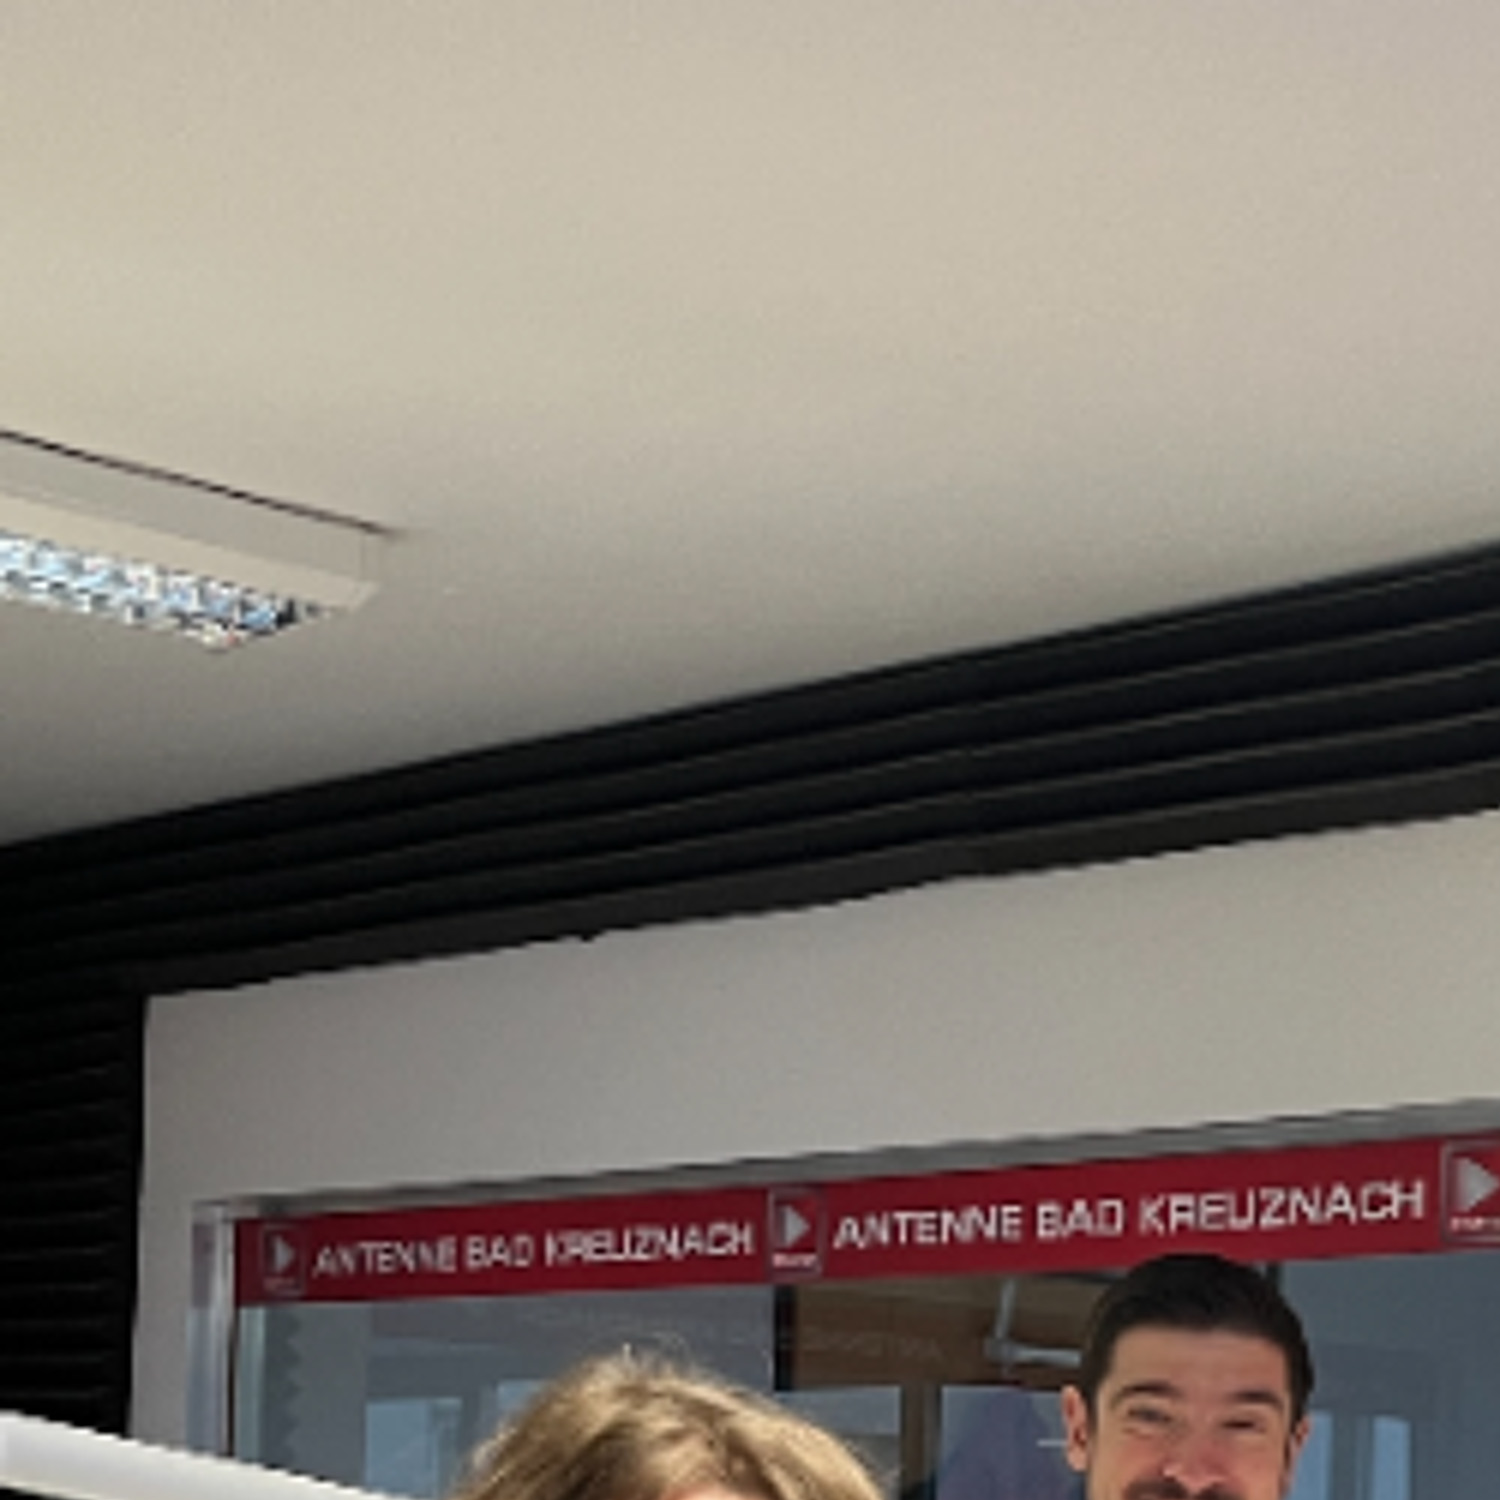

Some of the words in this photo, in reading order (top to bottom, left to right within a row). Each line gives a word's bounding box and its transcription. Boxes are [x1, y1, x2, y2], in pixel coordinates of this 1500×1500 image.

[833, 1205, 1022, 1249] ANTENNE
[1035, 1198, 1123, 1240] BAD
[1137, 1180, 1425, 1235] KREUZNACH
[311, 1236, 457, 1279] ANTENNE
[465, 1233, 534, 1270] BAD
[545, 1222, 754, 1267] KREUZNACH
